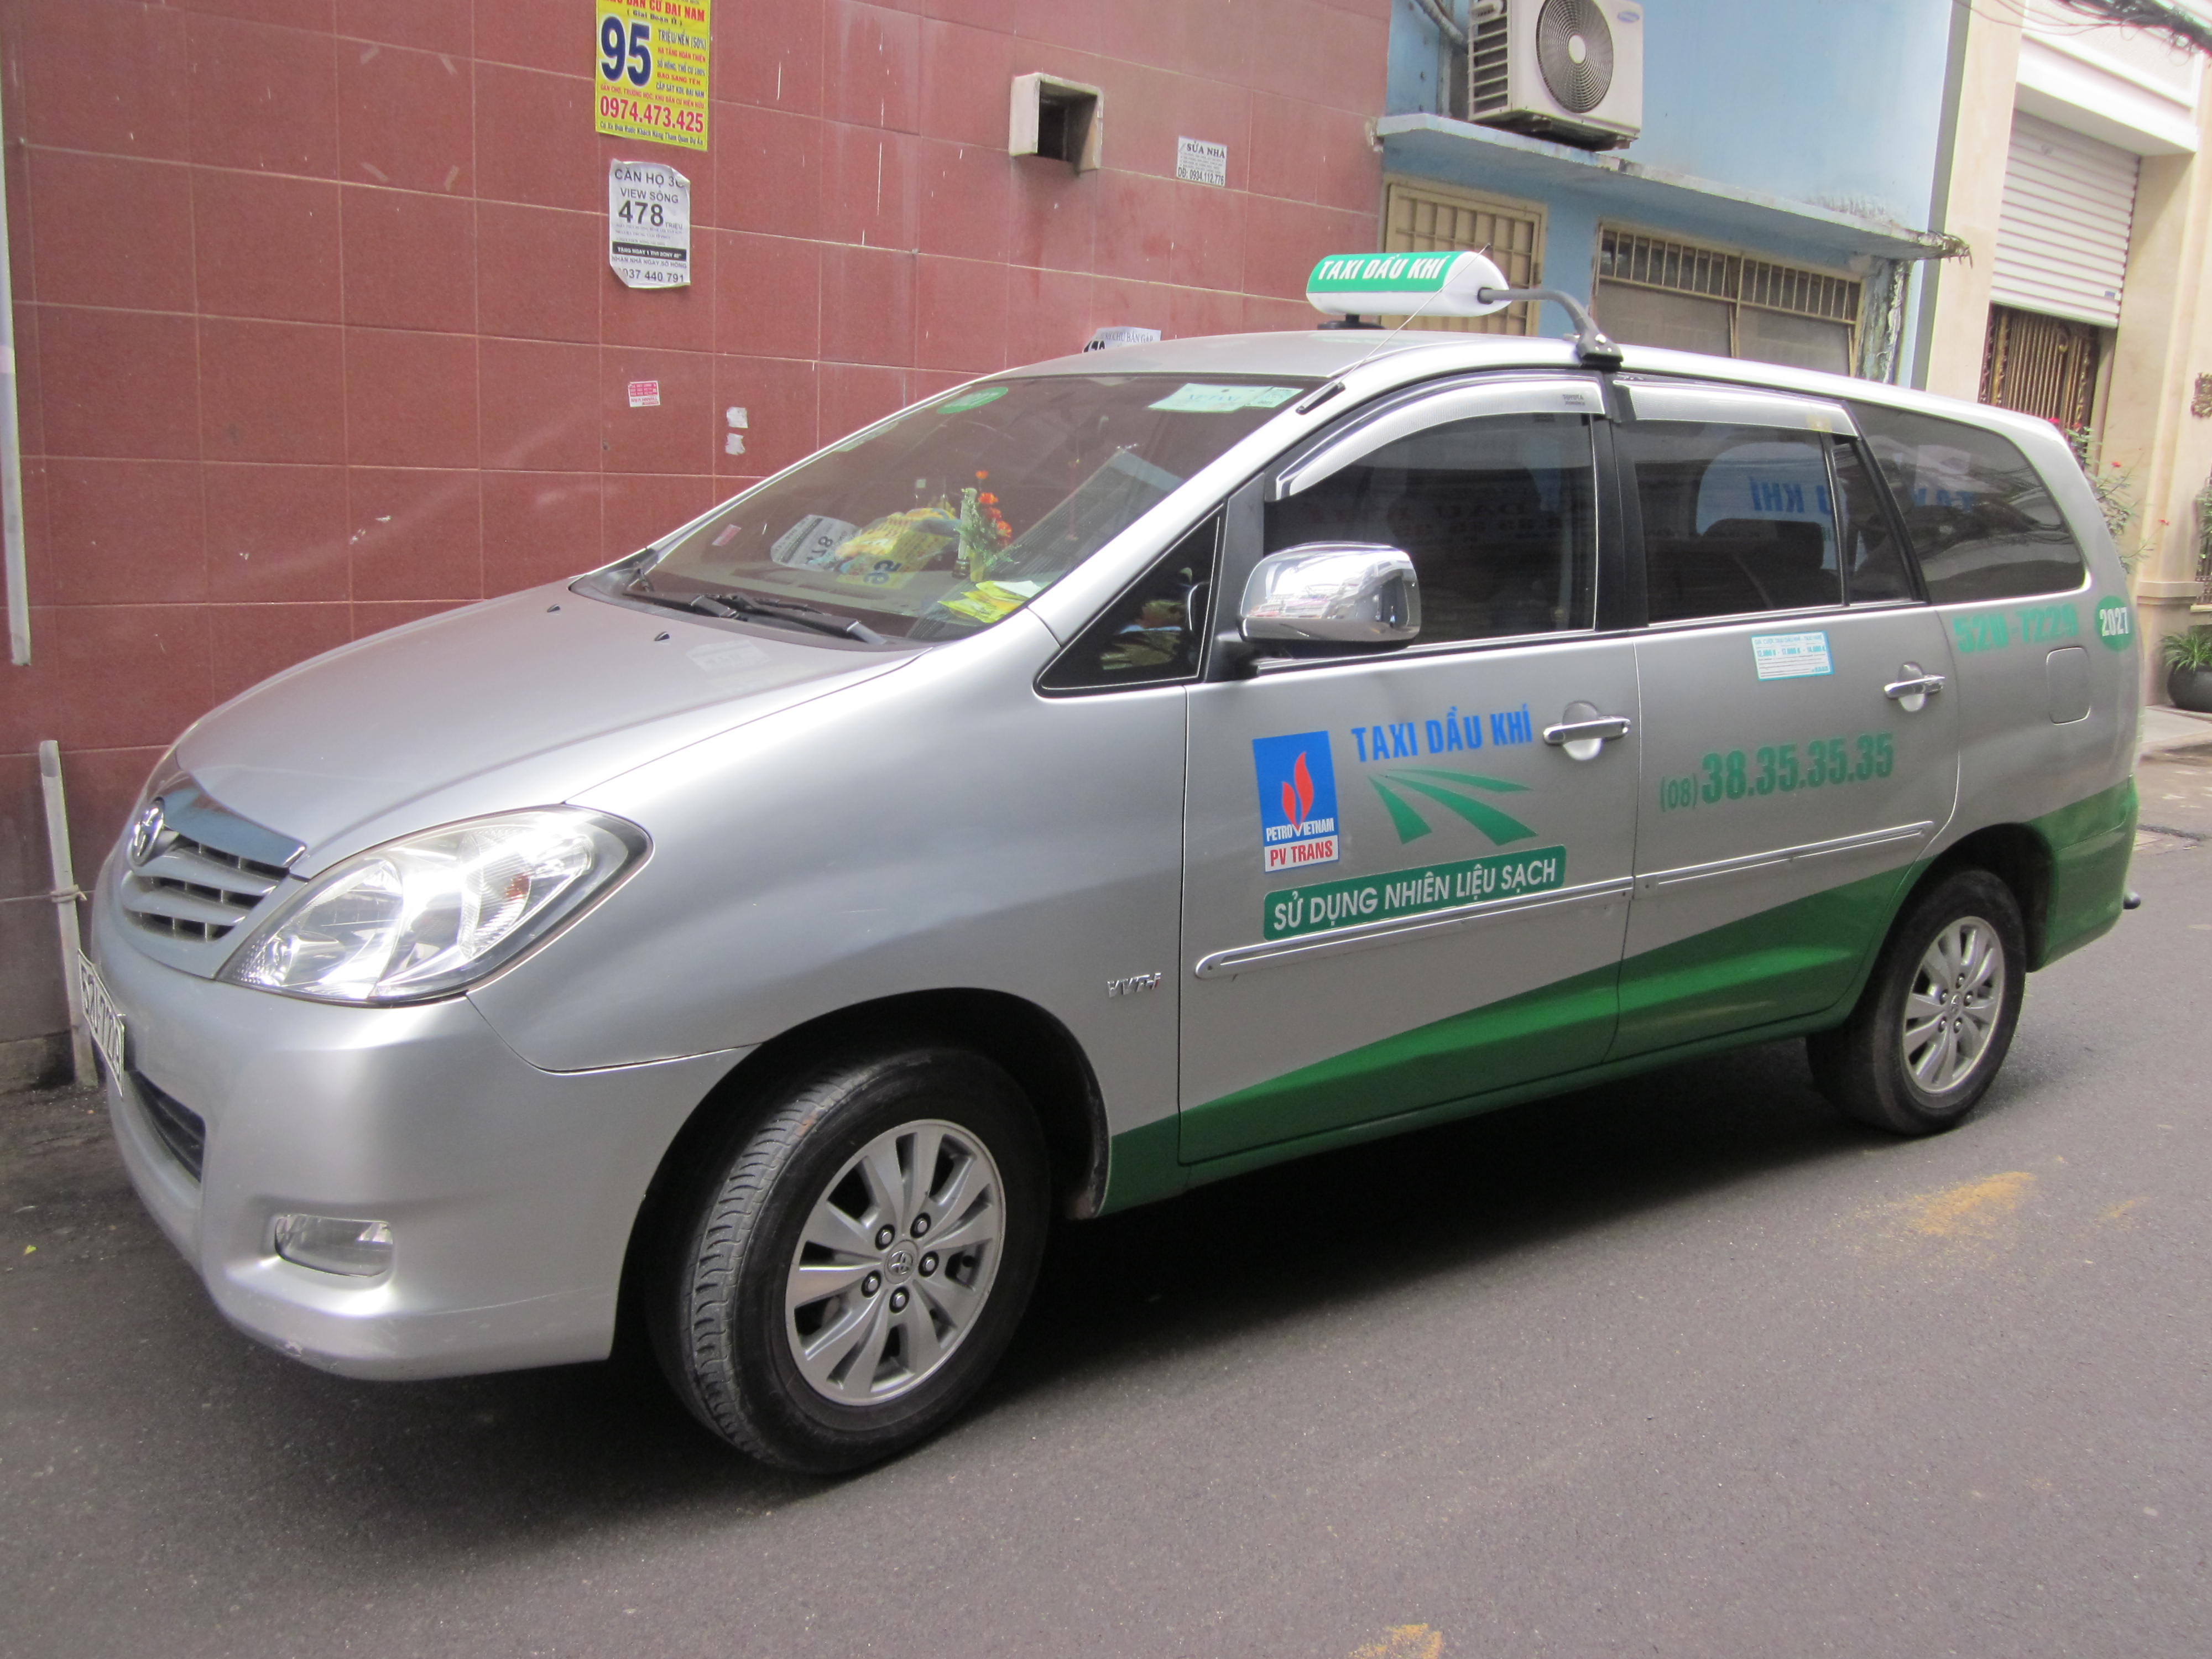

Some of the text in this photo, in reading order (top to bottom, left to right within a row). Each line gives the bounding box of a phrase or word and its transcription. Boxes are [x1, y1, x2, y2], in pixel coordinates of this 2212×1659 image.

[685, 6, 705, 22] NAM
[601, 15, 651, 85] 95
[600, 96, 703, 133] 0974.473.425
[1186, 141, 1204, 154] SỬA
[620, 187, 679, 204] VIEW SÔNG
[618, 200, 664, 227] 478
[644, 270, 663, 281] 440
[667, 273, 684, 283] 791
[1318, 259, 1365, 280] TAXI
[1406, 255, 1451, 279] KHÍ
[2100, 607, 2130, 637] 2027
[1351, 703, 1533, 762] TAXI DẦU KHÍ
[1660, 731, 1895, 813] (08) 38.35.35.35
[1266, 817, 1334, 842] PETROVIETNAM
[1270, 840, 1333, 867] PV TRANS
[1274, 858, 1557, 930] SỬ DỤNG NHIÊN LIỆU SẠCH
